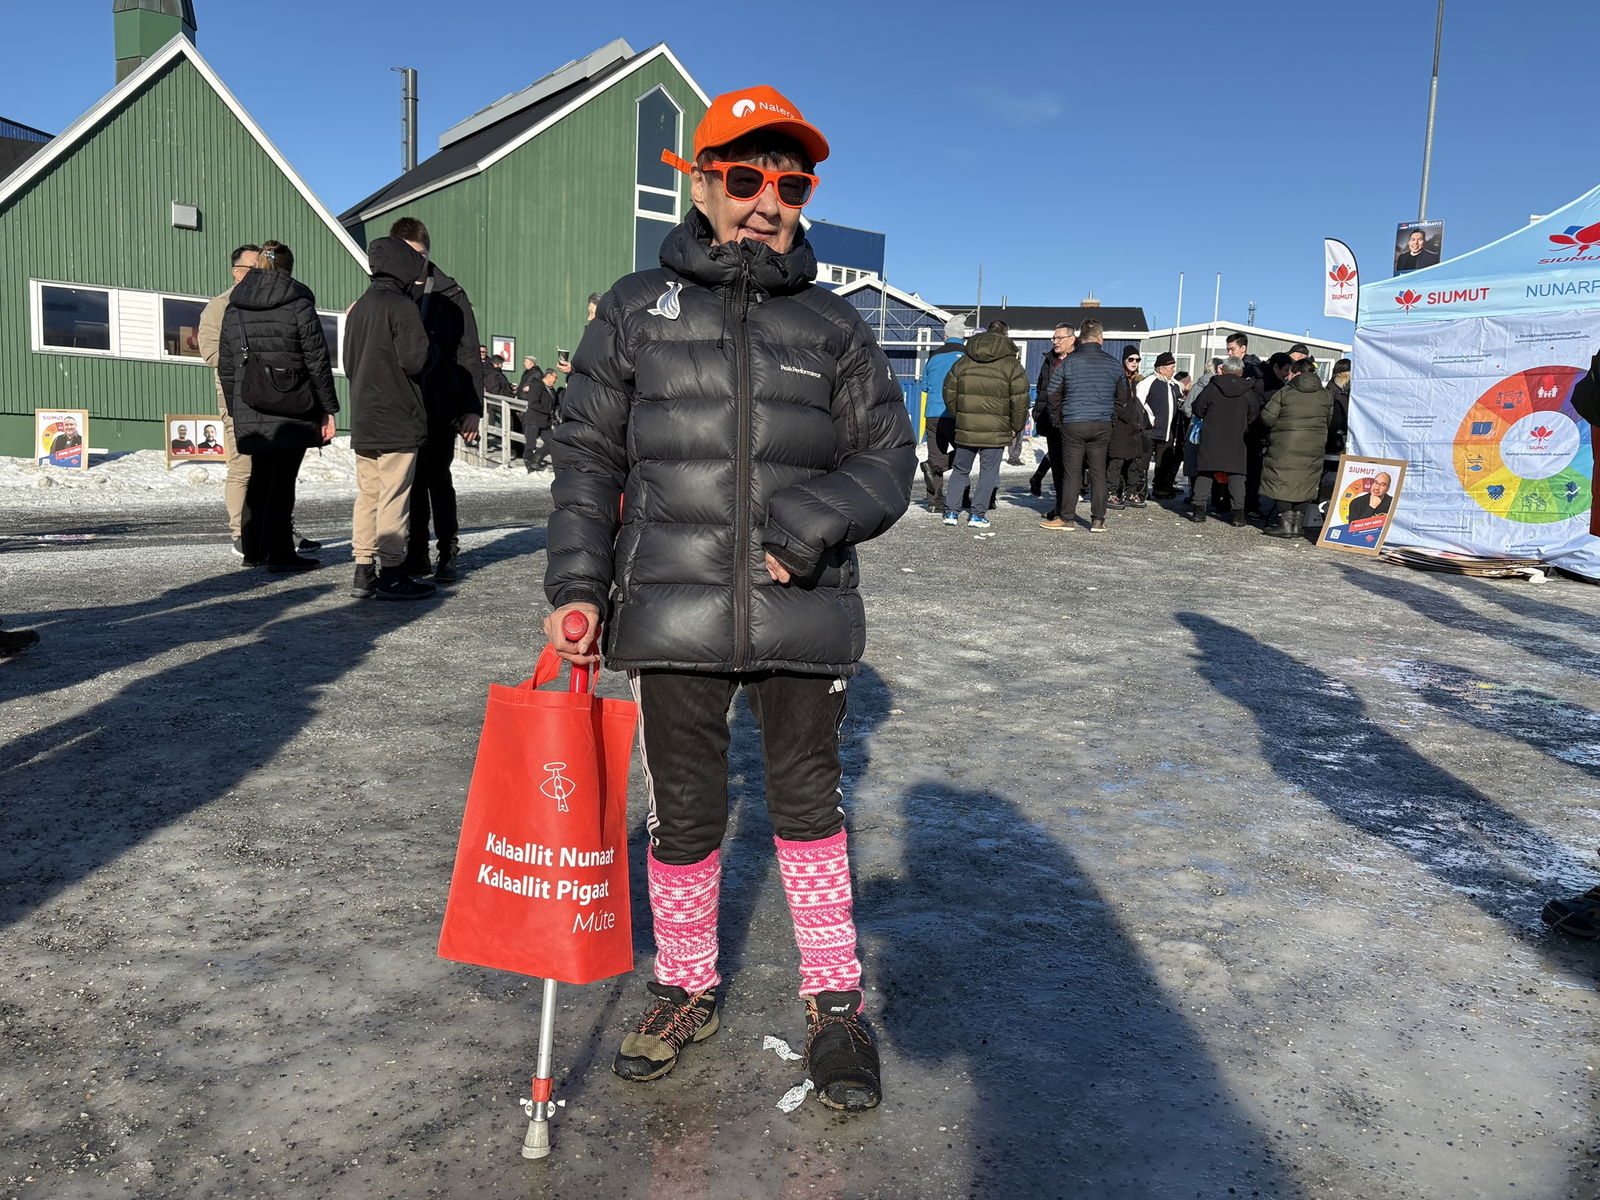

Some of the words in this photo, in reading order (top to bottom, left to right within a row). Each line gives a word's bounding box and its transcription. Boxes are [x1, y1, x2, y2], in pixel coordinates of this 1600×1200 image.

[1426, 287, 1490, 305] SIUMUT
[1348, 466, 1376, 475] SIUMUT
[485, 831, 553, 867] Kalaallit
[559, 846, 615, 868] Nunaat
[477, 863, 551, 899] Kalaallit
[556, 878, 609, 906] Pigaat
[572, 909, 616, 934] Múte
